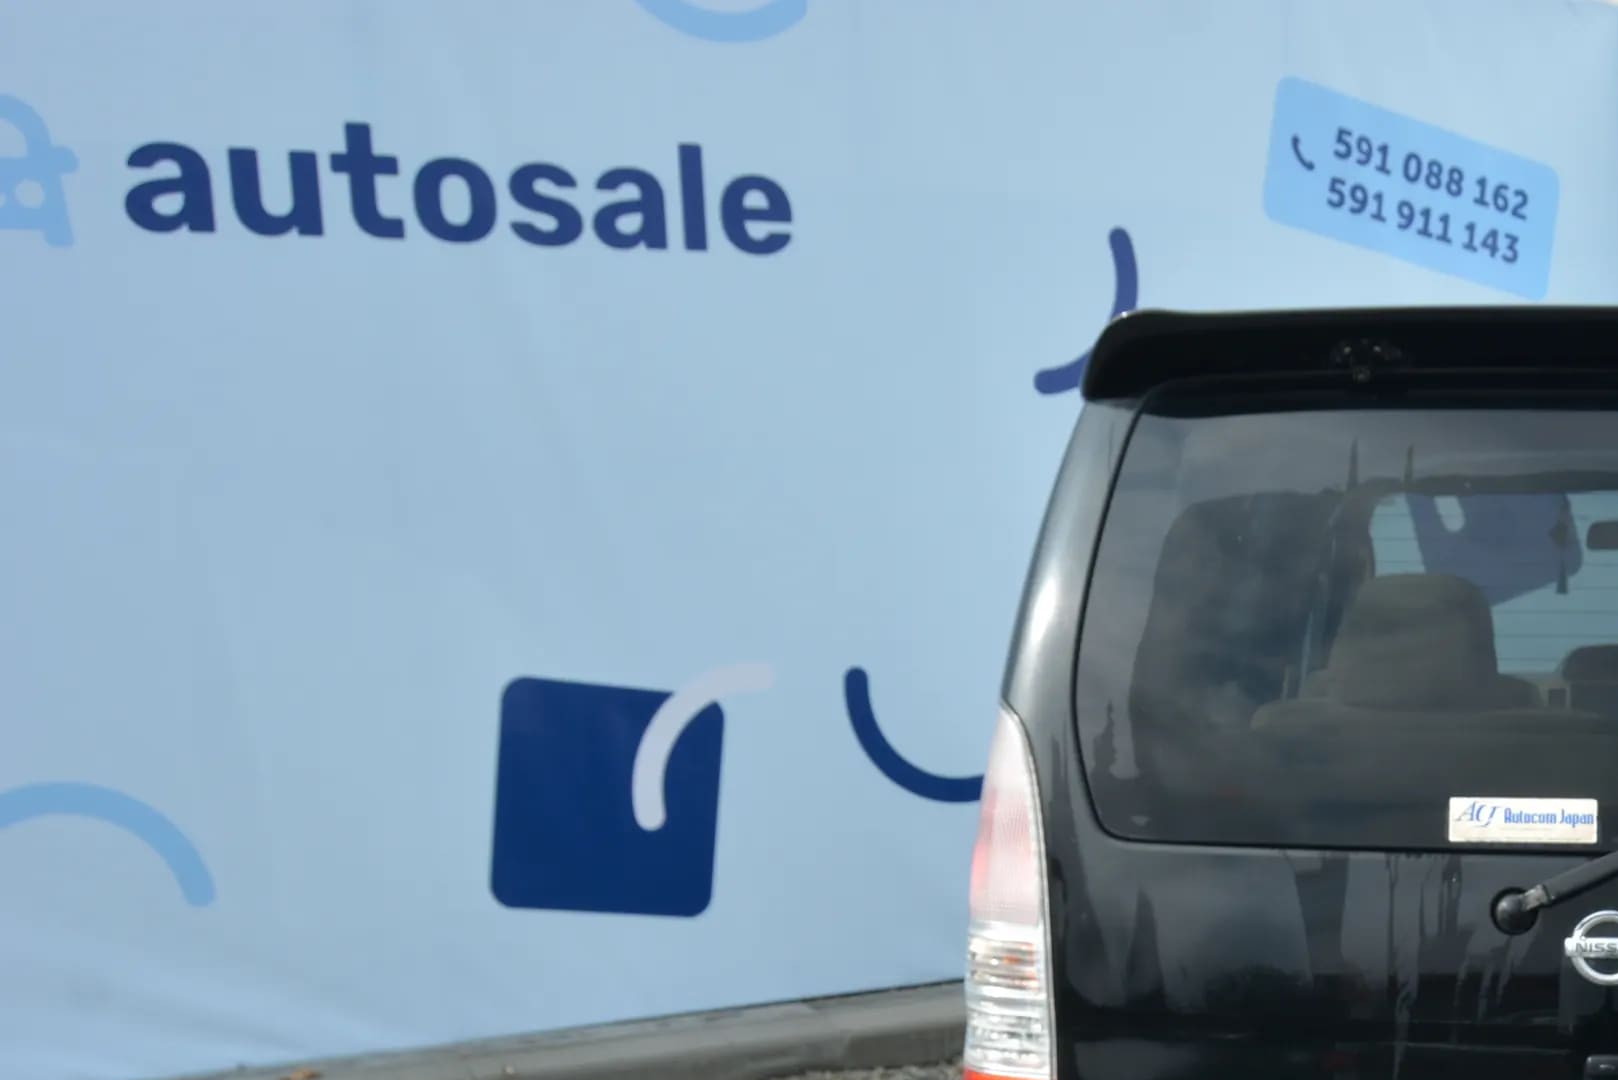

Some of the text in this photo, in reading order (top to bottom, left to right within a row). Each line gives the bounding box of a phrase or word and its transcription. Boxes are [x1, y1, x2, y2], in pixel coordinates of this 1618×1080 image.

[124, 122, 794, 256] autosale
[1333, 126, 1529, 221] 591 088 162
[1326, 176, 1520, 265] 591 911 143
[1503, 807, 1557, 825] Autocom
[1560, 808, 1595, 829] Japan
